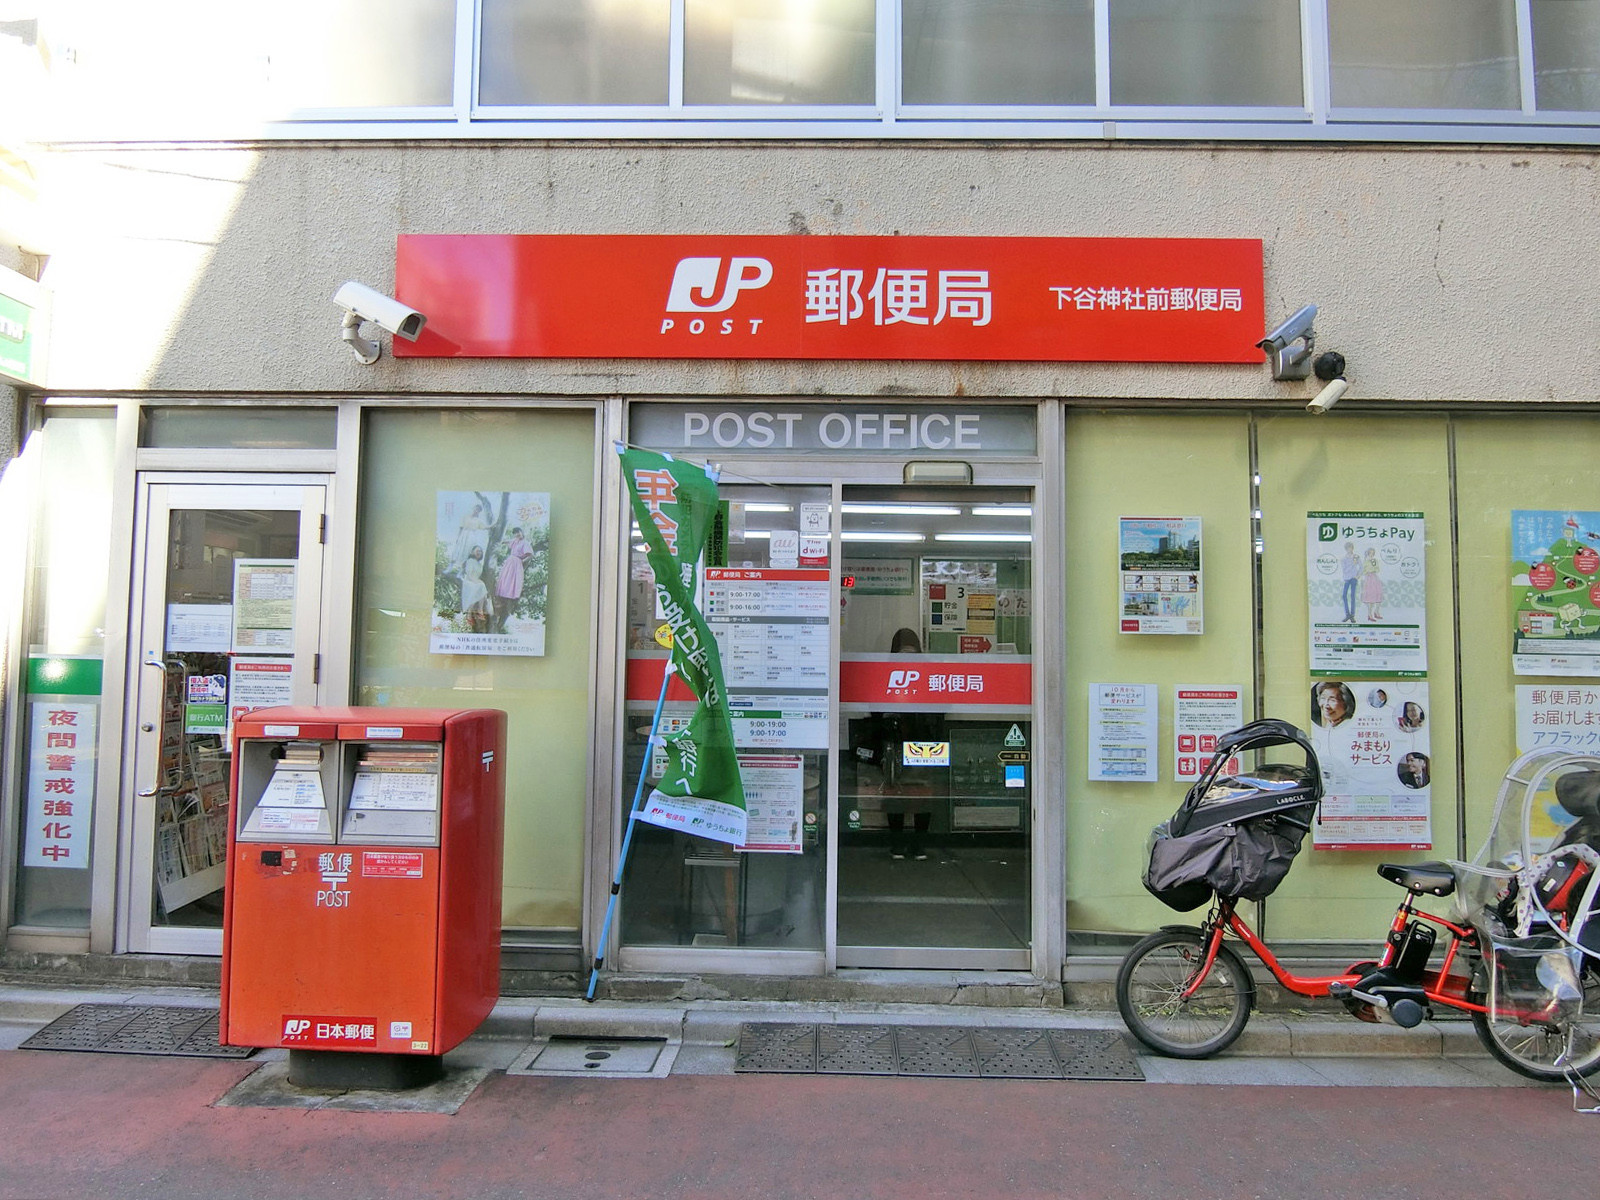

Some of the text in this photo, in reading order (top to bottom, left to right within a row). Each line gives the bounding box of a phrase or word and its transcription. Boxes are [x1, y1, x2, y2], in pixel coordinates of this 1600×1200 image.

[666, 256, 773, 314] JP
[804, 267, 993, 327] 郵便局
[1048, 285, 1243, 313] 下谷神社前郵便局
[660, 318, 765, 336] POST
[683, 412, 982, 451] POST OFFICE
[1342, 526, 1415, 542] ゆうちょPay
[957, 587, 965, 599] 3
[928, 674, 985, 693] 郵便局
[1350, 740, 1391, 752] みまもり
[1533, 731, 1600, 745] アフラック
[1350, 753, 1392, 765] サービス
[706, 821, 744, 837] ゆうちょ銀行
[318, 852, 353, 873] 郵便
[317, 890, 351, 908] POST
[316, 1023, 375, 1040] 日本郵便
